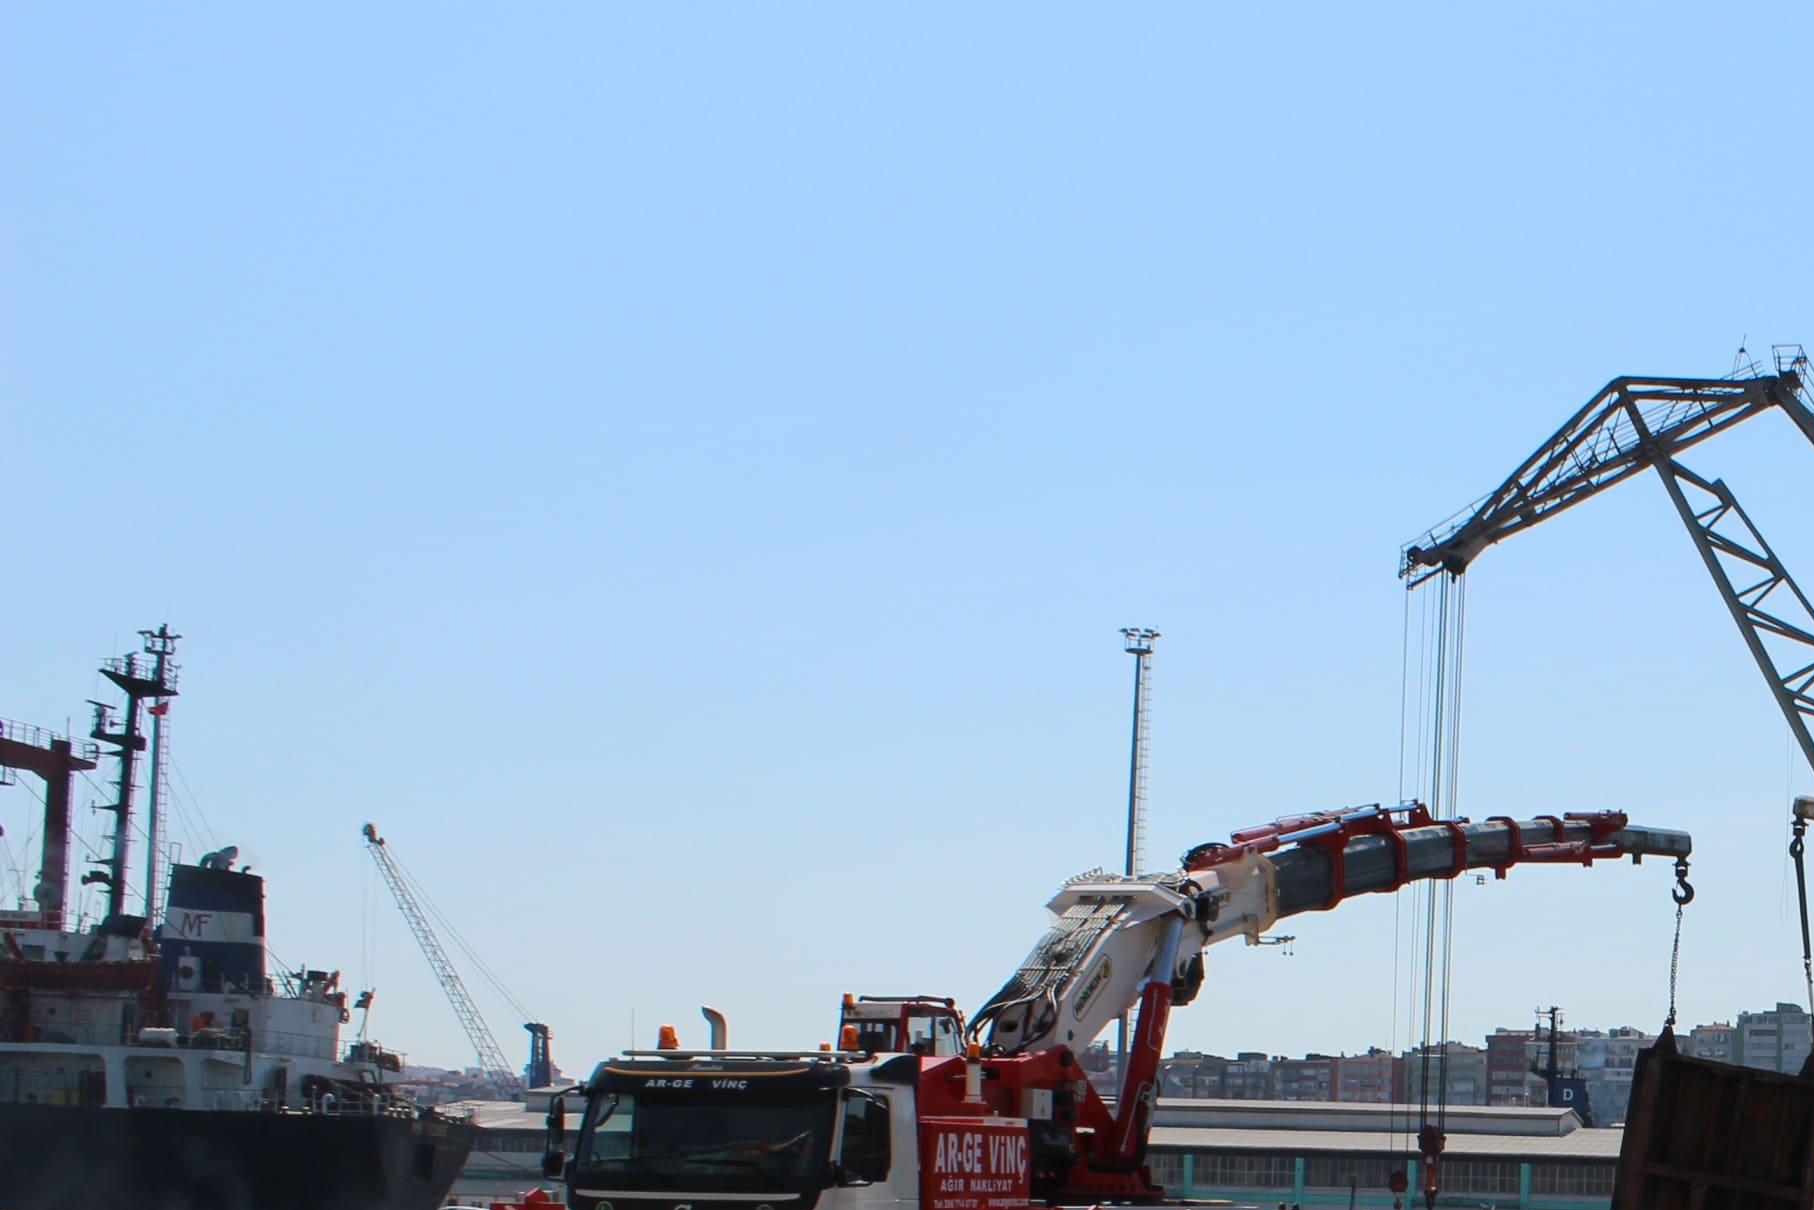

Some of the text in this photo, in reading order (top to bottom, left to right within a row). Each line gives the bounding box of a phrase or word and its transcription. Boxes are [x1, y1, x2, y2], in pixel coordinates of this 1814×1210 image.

[182, 912, 212, 936] MF
[645, 1079, 693, 1088] AR-GE
[934, 1131, 983, 1173] AR-GE
[940, 1175, 965, 1192] AĞIR
